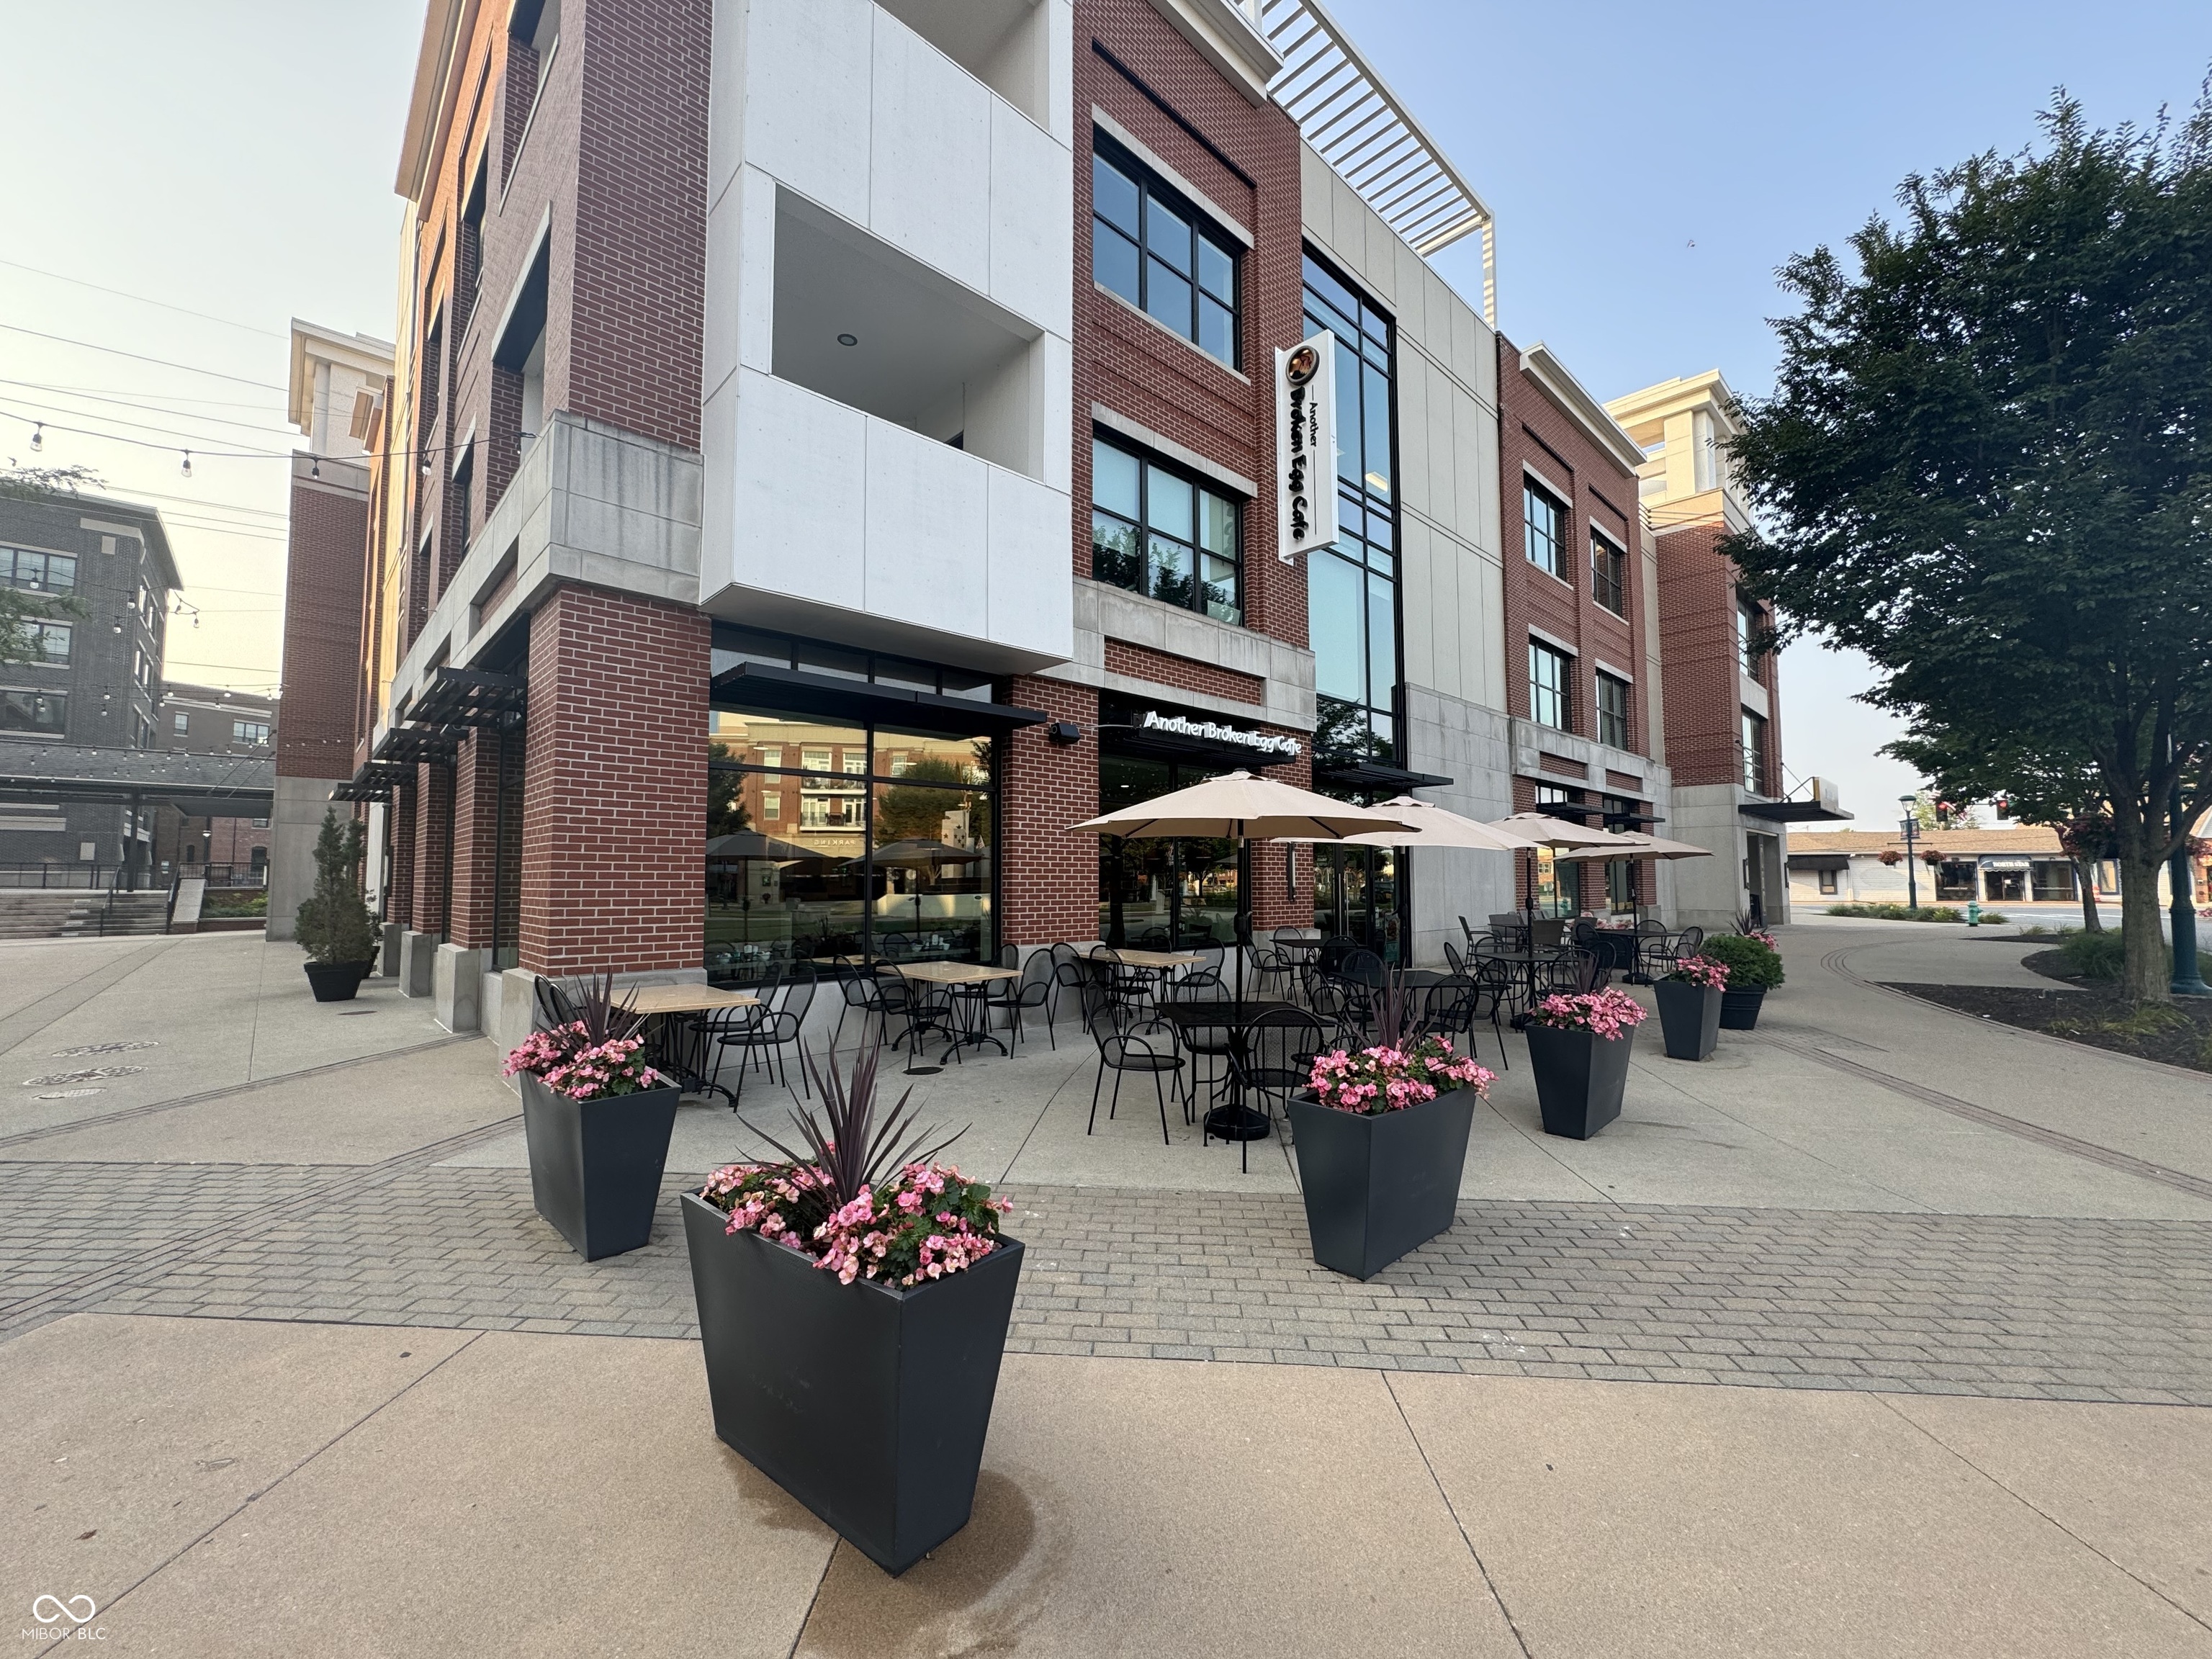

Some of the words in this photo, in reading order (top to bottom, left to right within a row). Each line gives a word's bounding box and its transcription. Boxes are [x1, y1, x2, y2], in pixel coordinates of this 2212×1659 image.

[1290, 386, 1307, 454] Broken
[1309, 402, 1318, 446] Another
[1289, 454, 1307, 493] Egg
[1290, 495, 1308, 540] Cafe
[1144, 711, 1205, 737] Another
[1205, 721, 1250, 745] Broken
[1250, 731, 1274, 752] Egg
[1277, 735, 1302, 755] Cafe
